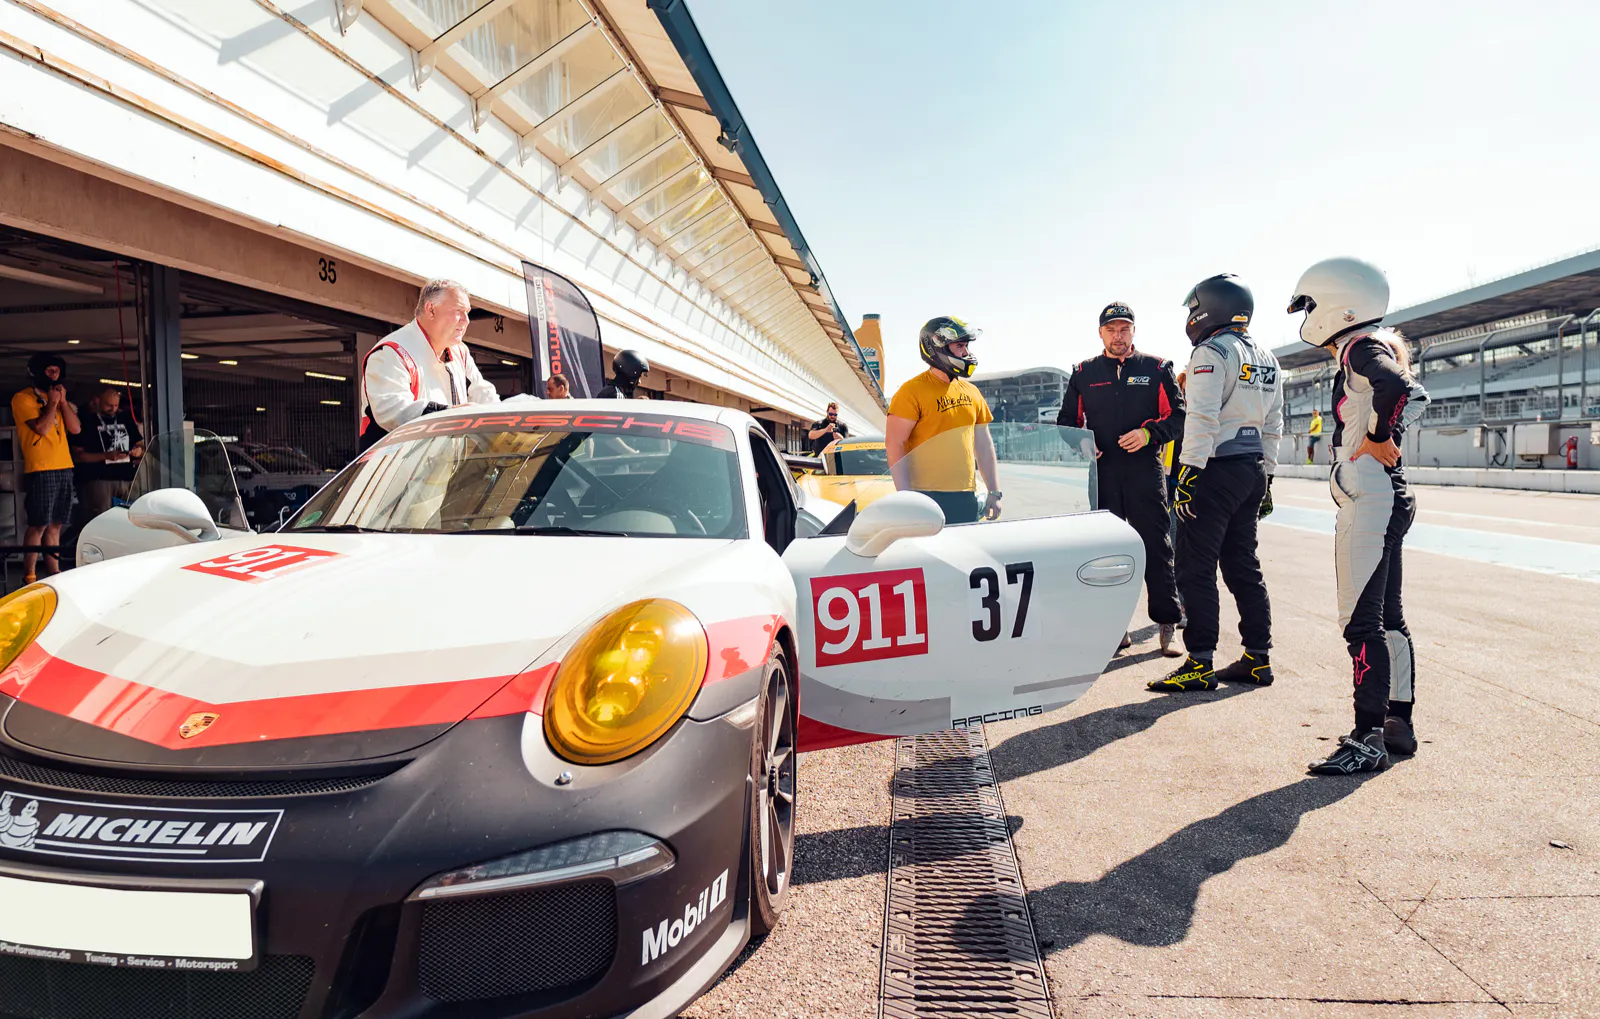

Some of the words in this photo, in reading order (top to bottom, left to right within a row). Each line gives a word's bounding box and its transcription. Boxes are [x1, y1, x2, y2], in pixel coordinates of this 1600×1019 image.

[318, 257, 337, 284] 35
[494, 315, 504, 335] 34
[936, 394, 956, 412] Nike
[385, 414, 728, 444] PORSCHE
[199, 547, 332, 579] 911
[969, 561, 1035, 642] 37
[816, 579, 926, 656] 911
[952, 704, 1044, 730] RACING
[43, 812, 268, 846] MICHELIN
[641, 886, 710, 966] Mobil
[84, 952, 118, 967] Tuning
[127, 956, 165, 968] Service
[175, 958, 238, 971] Motorsport
